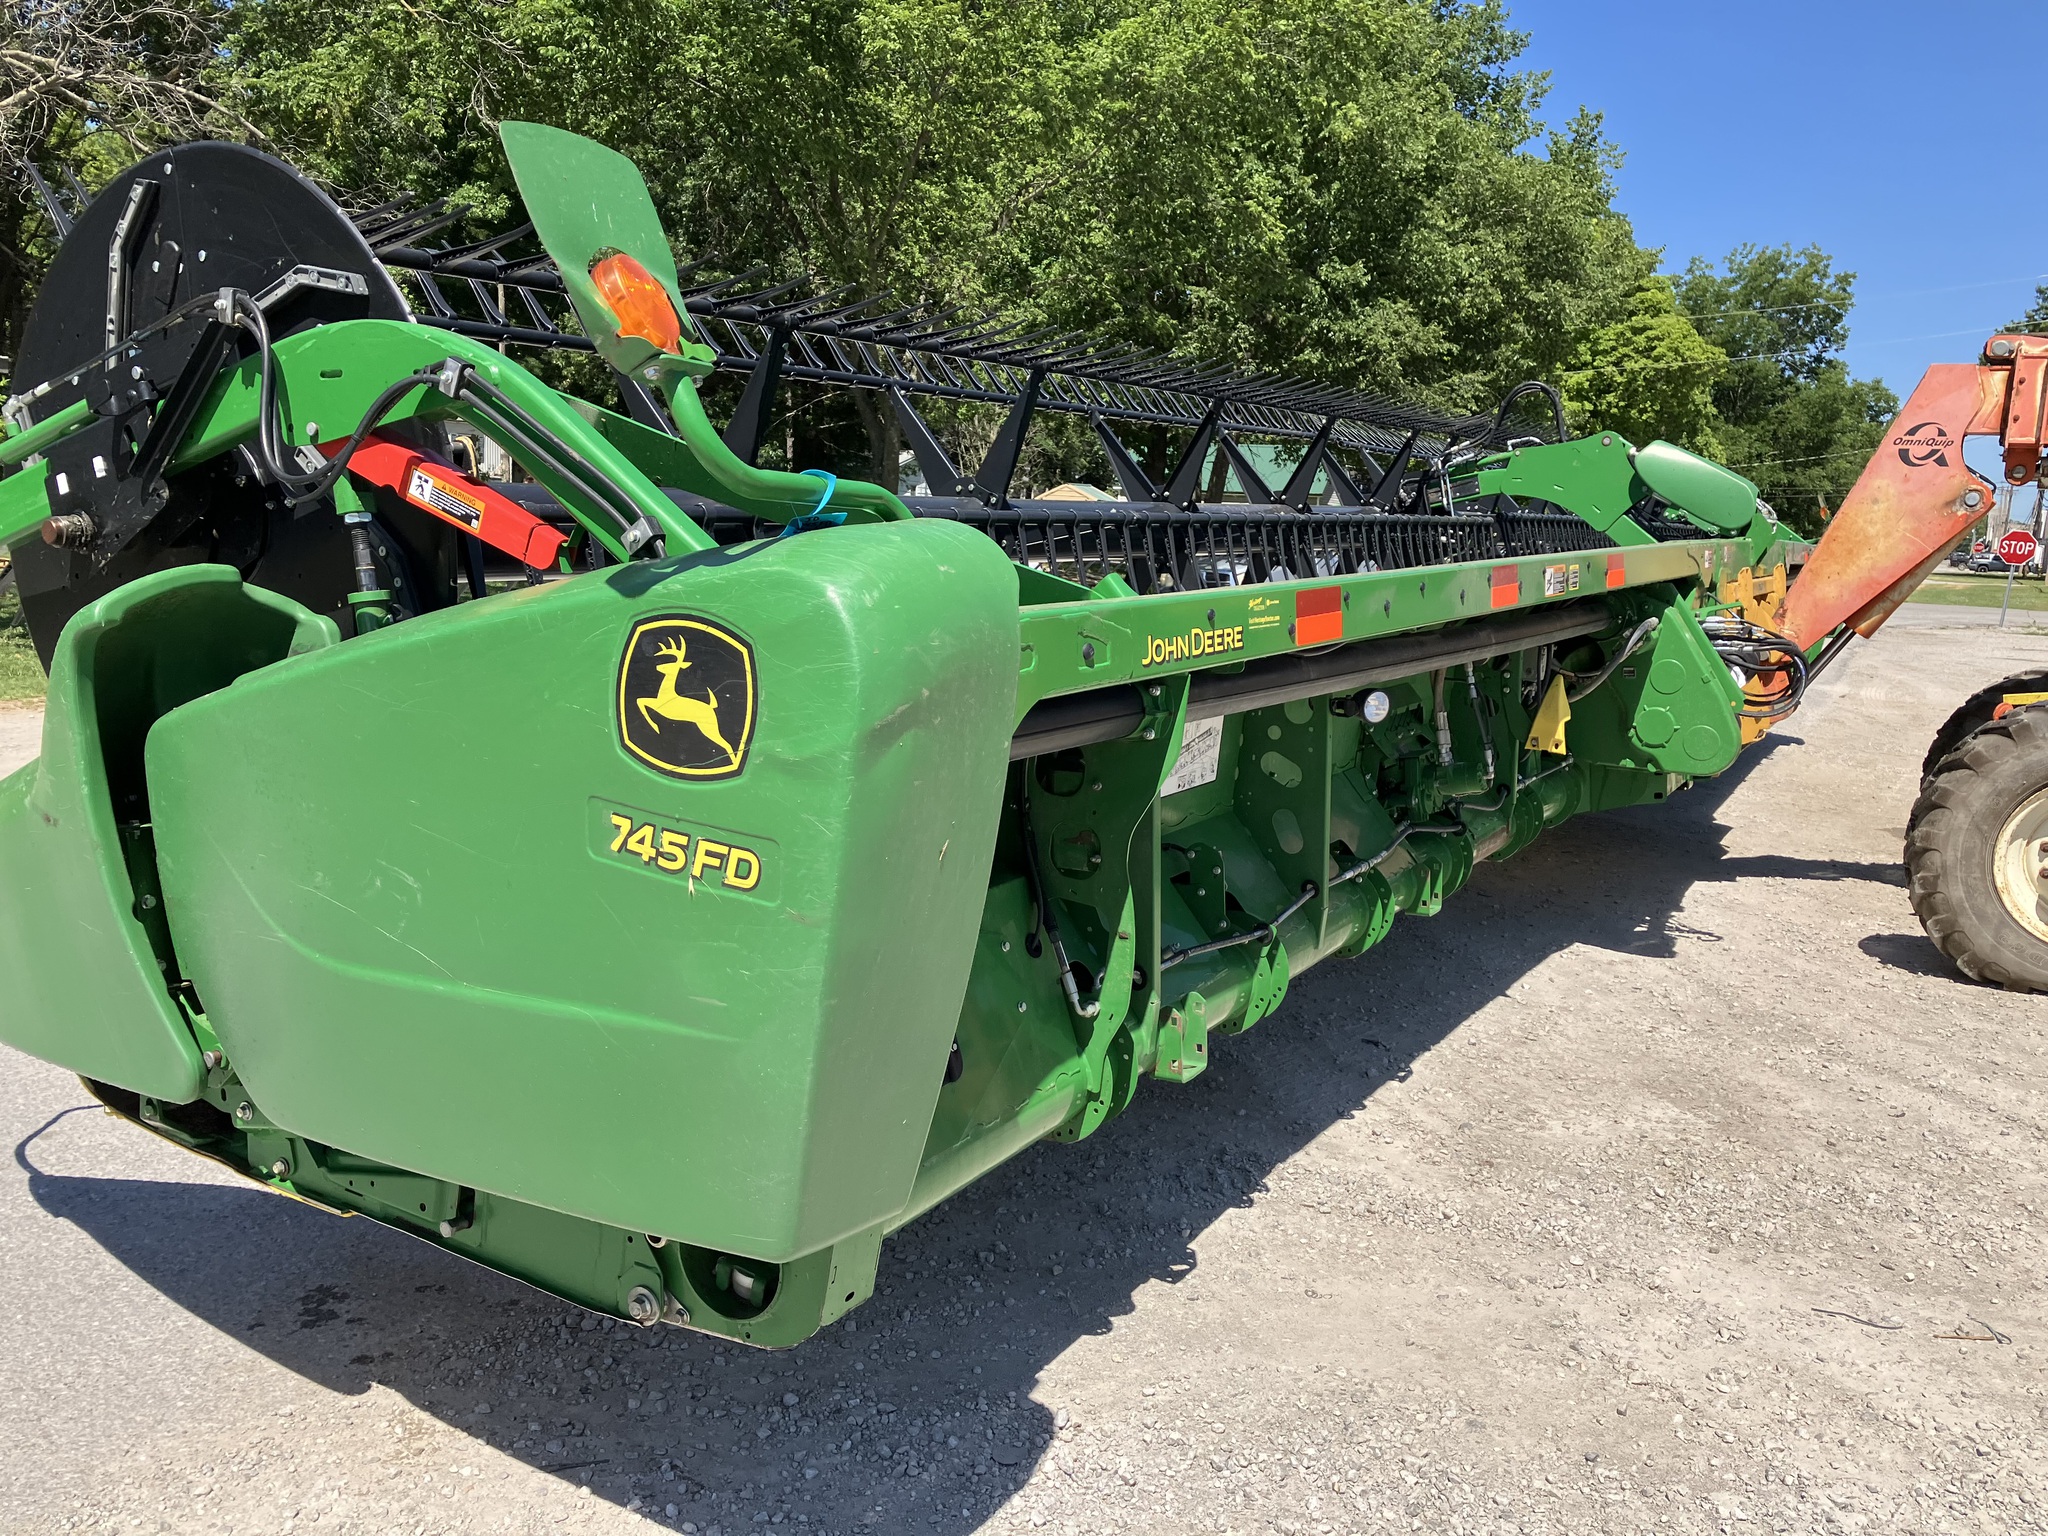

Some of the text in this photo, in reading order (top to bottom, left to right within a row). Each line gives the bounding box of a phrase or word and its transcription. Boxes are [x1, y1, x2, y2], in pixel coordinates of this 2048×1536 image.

[1893, 437, 1954, 448] OmniQuip
[448, 486, 476, 506] WARNING
[2000, 540, 2035, 555] STOP
[1141, 625, 1244, 668] JOHN DEERE
